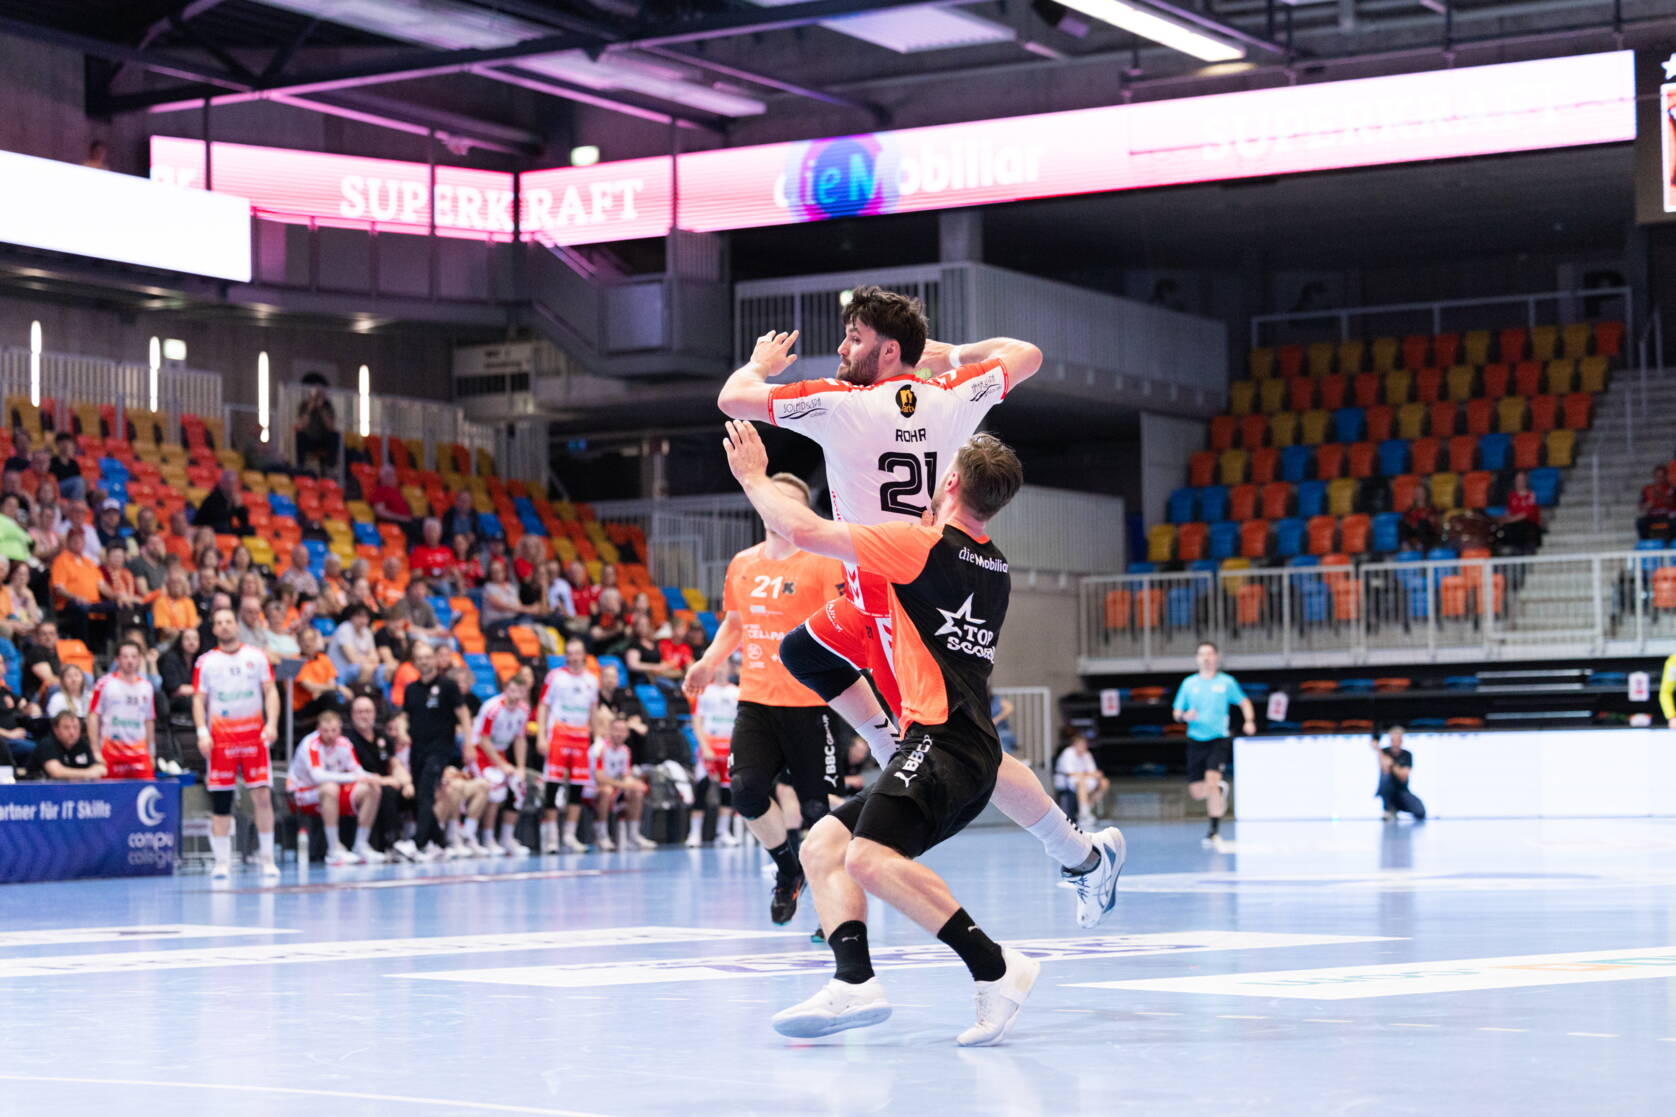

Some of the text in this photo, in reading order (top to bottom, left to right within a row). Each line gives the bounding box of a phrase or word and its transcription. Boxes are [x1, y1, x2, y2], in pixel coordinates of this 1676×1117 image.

[1200, 78, 1570, 160] SUPERKRAFT
[340, 174, 644, 233] SUPERKRAFT
[895, 427, 927, 443] ROHR
[878, 451, 938, 518] 21
[958, 546, 1009, 573] dieMobilia
[750, 575, 783, 599] 21
[963, 624, 994, 646] TOP
[823, 745, 837, 775] BBC
[901, 743, 931, 772] BBC
[40, 800, 59, 820] für
[62, 800, 75, 819] IT
[77, 799, 111, 819] Skills
